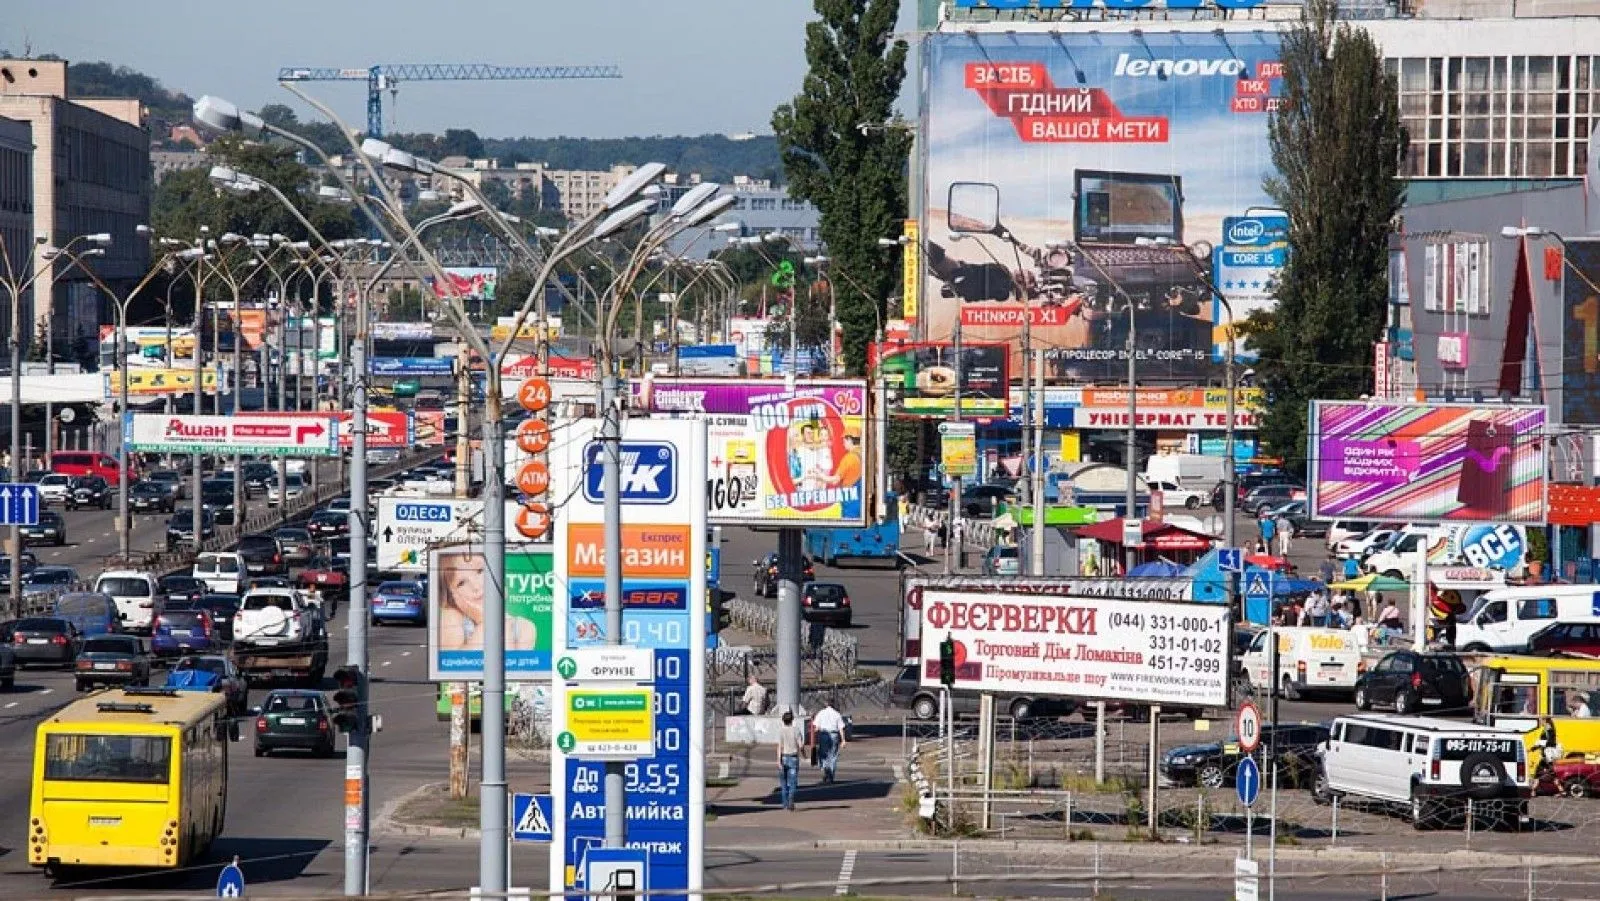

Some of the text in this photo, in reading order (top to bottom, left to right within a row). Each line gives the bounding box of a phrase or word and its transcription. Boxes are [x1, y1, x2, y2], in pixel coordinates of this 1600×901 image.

[974, 67, 1036, 85] ЗАСІБ,
[1008, 88, 1092, 112] ГІДНИЙ
[1234, 97, 1257, 109] ХТО
[1032, 119, 1160, 138] ВАШОЇ МЕТИ
[1233, 254, 1259, 264] CORE
[1040, 309, 1057, 322] X1
[1062, 350, 1116, 361] ПРОЦЕСОР
[525, 387, 547, 404] 24
[165, 419, 228, 437] Ашан
[1089, 413, 1196, 426] УНІВЕРМАГ
[522, 471, 548, 486] ATM
[398, 506, 449, 520] ОДЕСА
[641, 532, 682, 543] Експрес
[1464, 525, 1520, 568] ВСЕ
[927, 601, 1221, 635] ФЕЄРВЕРКИ (044) 331-000-1
[1148, 635, 1222, 653] 331-01-02
[1310, 633, 1344, 649] Yale
[974, 638, 1144, 665] Торговий Дім Ломакіна
[591, 666, 636, 677] ФРУНЗЕ
[1148, 656, 1220, 674] 451-7-999
[986, 665, 1081, 684] Піромузикальне
[1084, 672, 1108, 688] шоу
[1242, 719, 1254, 738] 10
[624, 763, 680, 787] 9.55
[571, 801, 684, 819] Автмийка
